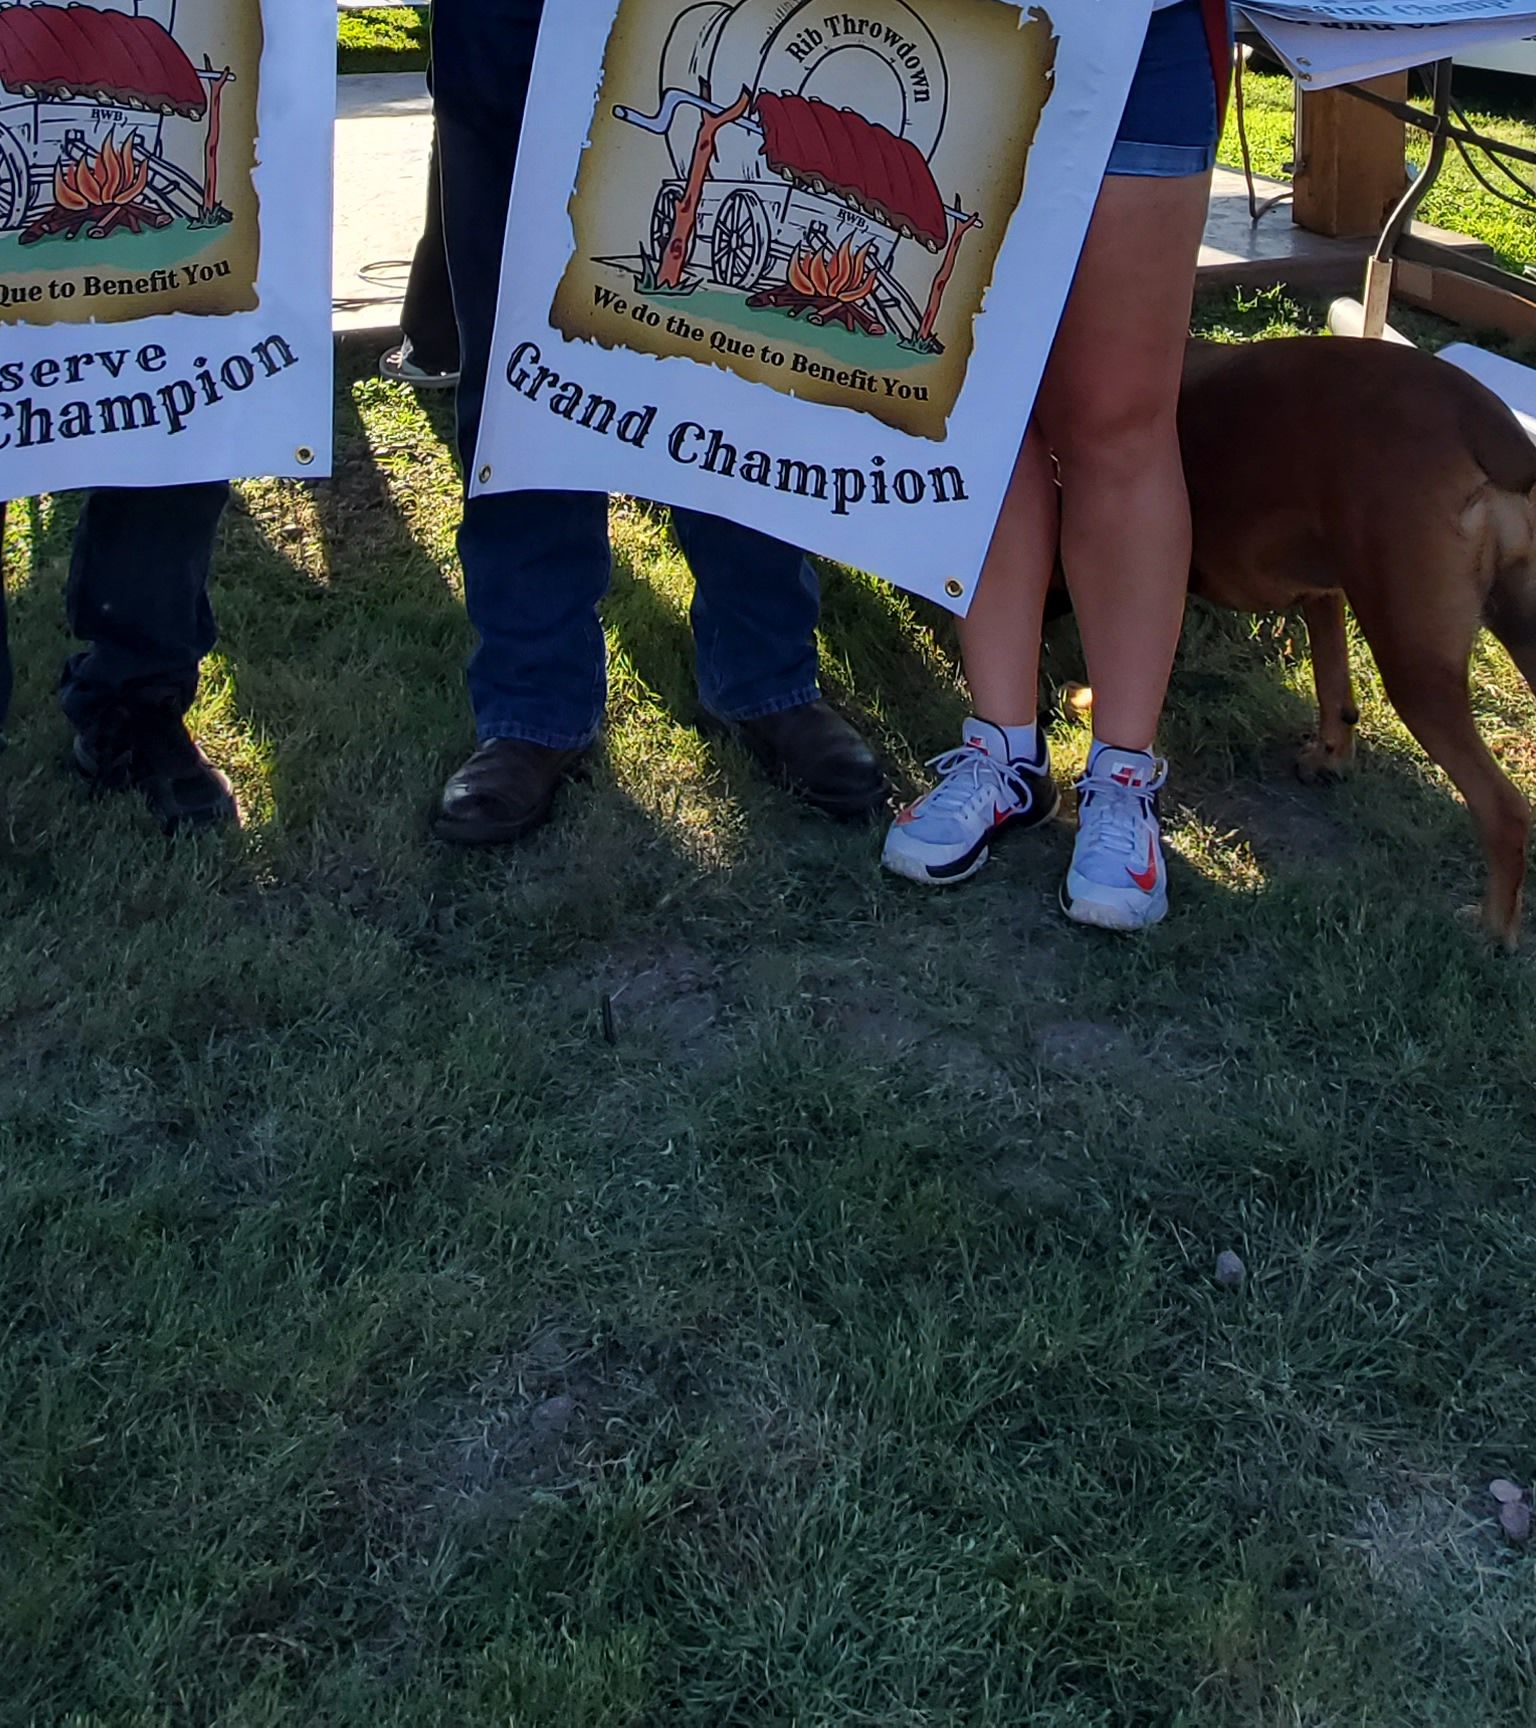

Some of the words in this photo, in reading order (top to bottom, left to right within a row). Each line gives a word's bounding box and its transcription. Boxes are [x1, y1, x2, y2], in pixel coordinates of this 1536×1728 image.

[784, 23, 824, 65] Rib
[822, 11, 931, 105] Throwdown
[90, 107, 124, 123] BWB
[835, 207, 866, 229] BWB
[48, 277, 76, 300] to
[82, 268, 180, 299] Benefit
[183, 257, 232, 288] You
[592, 284, 628, 314] We
[631, 301, 662, 329] do
[664, 315, 705, 343] the
[708, 329, 757, 362] Que
[760, 343, 786, 367] to
[791, 352, 879, 395] Benefit
[880, 375, 930, 403] You
[504, 339, 658, 450] Grand
[665, 417, 970, 516] Champion
